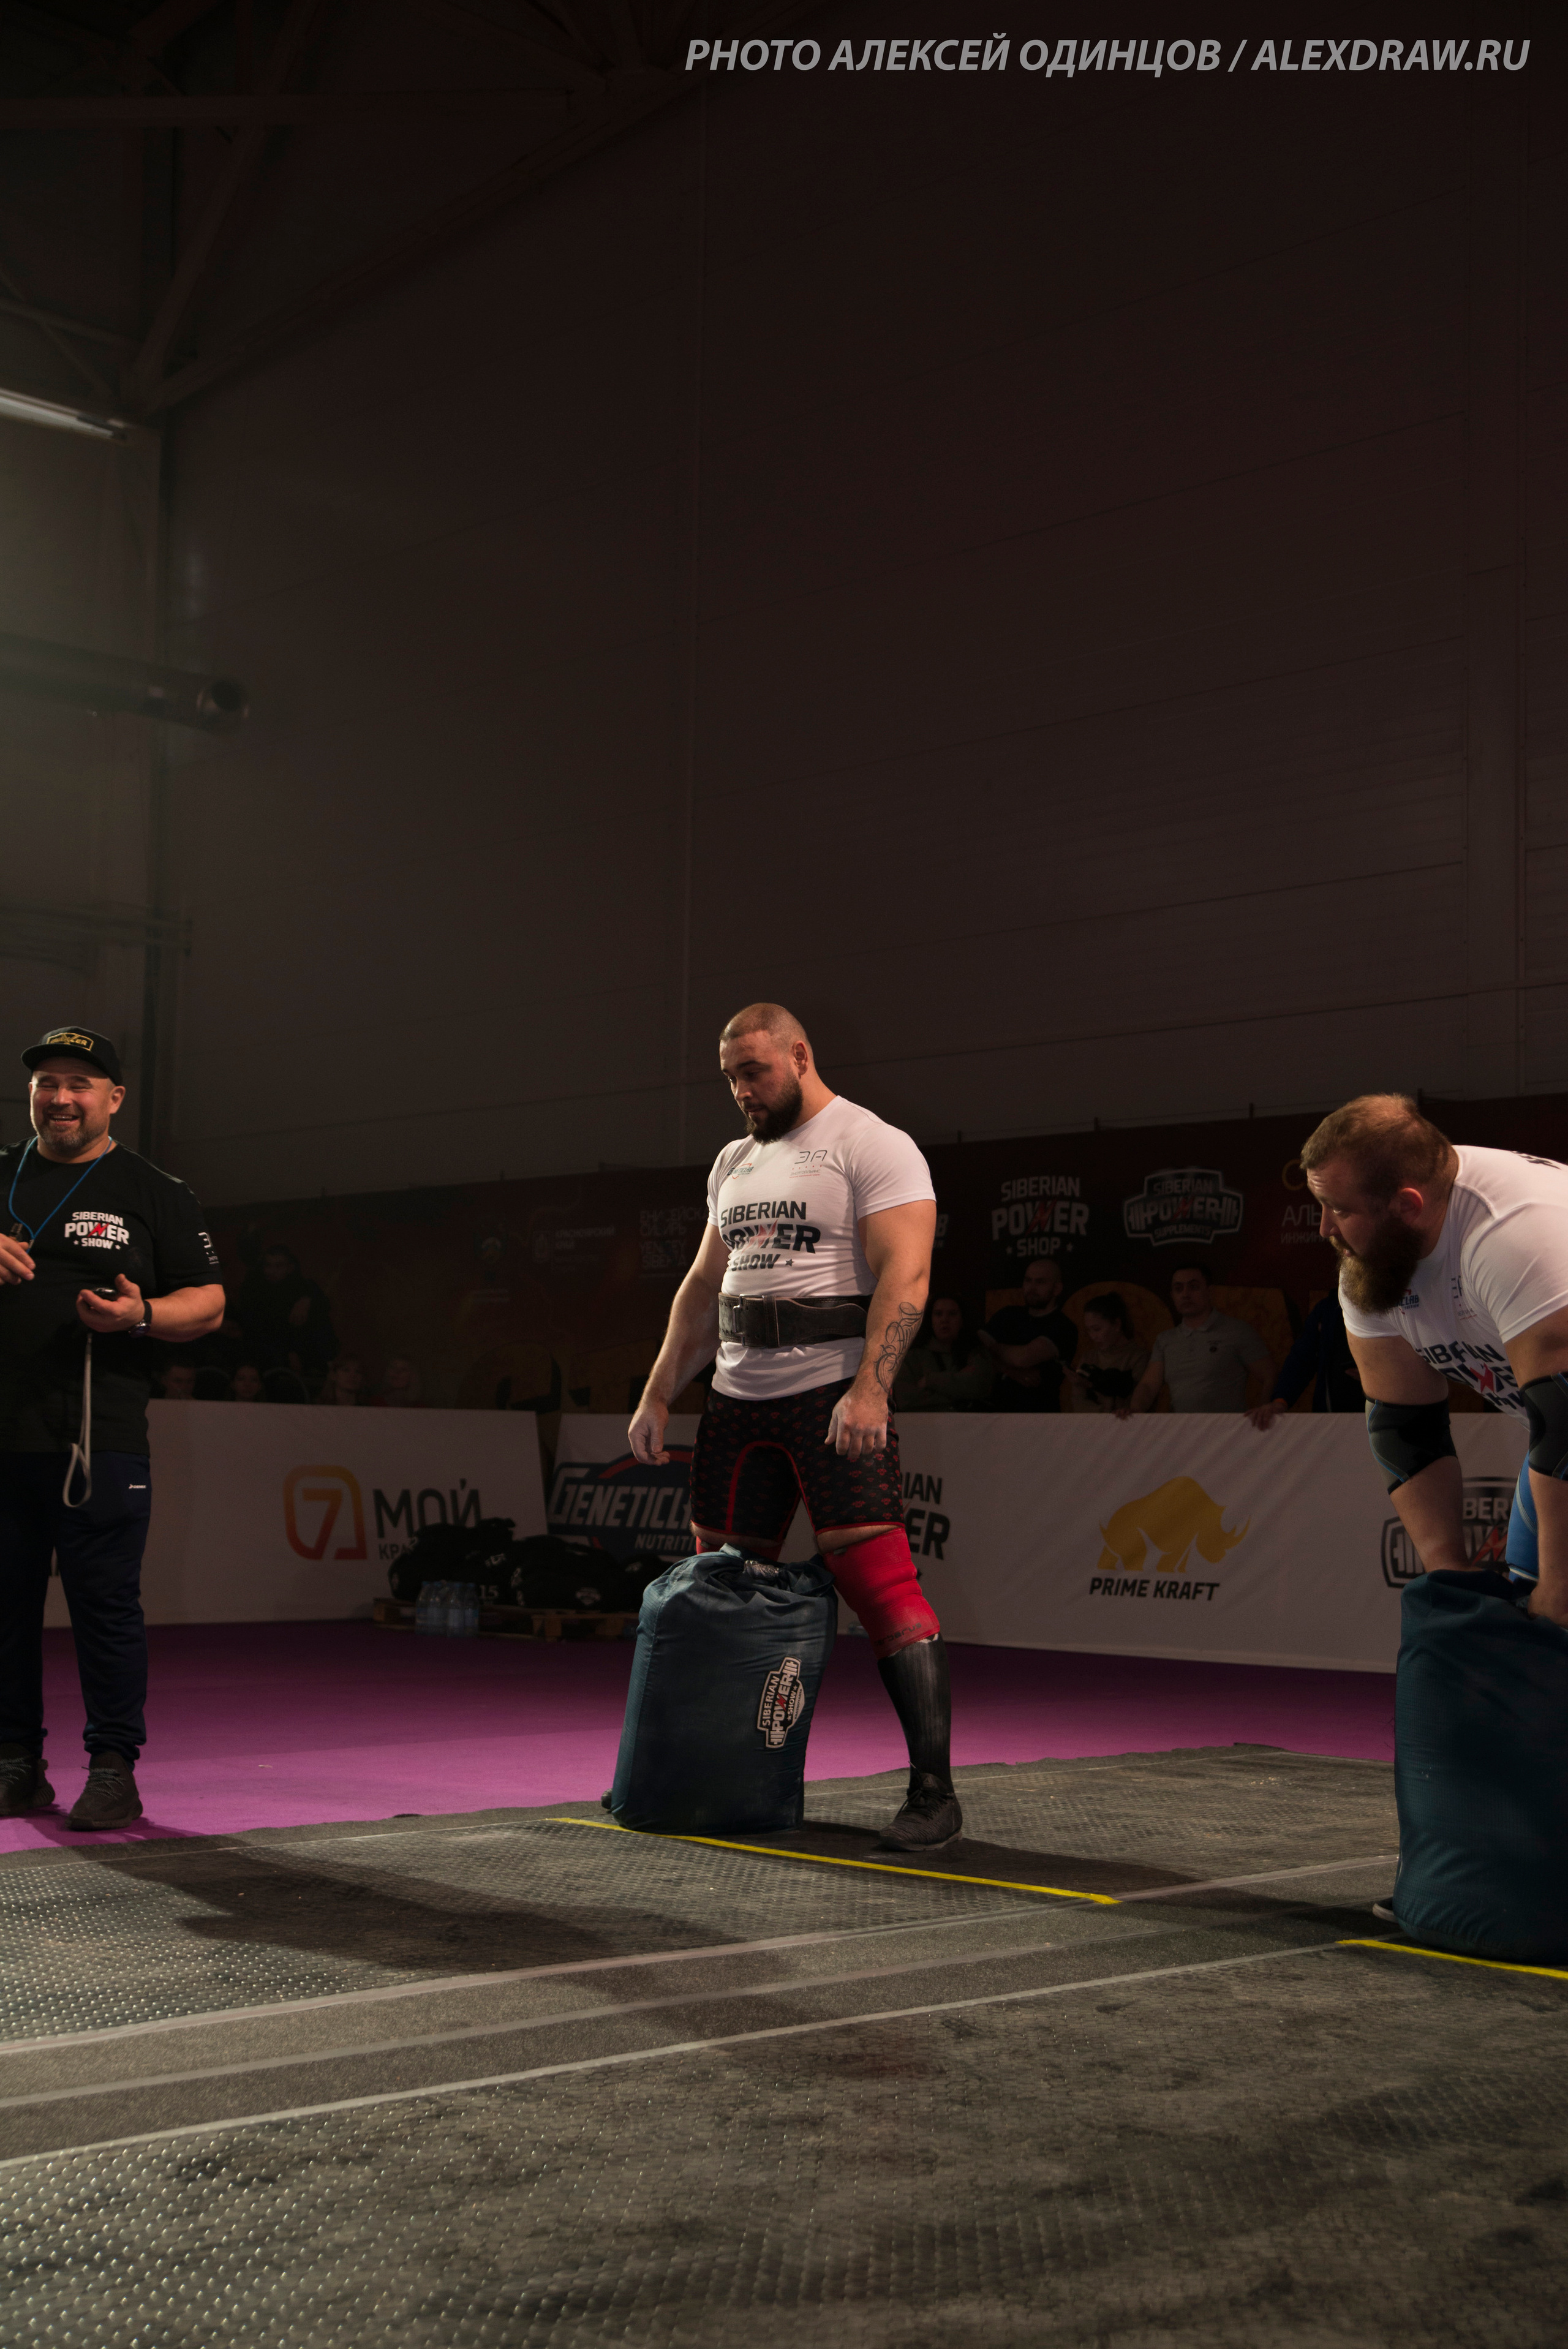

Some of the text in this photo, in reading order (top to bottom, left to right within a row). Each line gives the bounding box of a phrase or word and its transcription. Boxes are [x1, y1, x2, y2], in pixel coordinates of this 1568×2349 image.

[1000, 1175, 1080, 1202] SIBERIAN
[1152, 1177, 1213, 1197] SIBERIAN
[72, 1211, 124, 1227] SIBERIAN
[721, 1201, 806, 1228] SIBERIAN
[991, 1199, 1090, 1241] POWER
[1146, 1195, 1220, 1224] POWER
[1281, 1204, 1322, 1227] АЛЬ
[64, 1221, 130, 1245] POWER
[1153, 1223, 1212, 1239] SUPPLEMENTS
[80, 1237, 115, 1250] SHOW
[1016, 1236, 1061, 1257] SHOP
[731, 1254, 782, 1272] SHOW
[372, 1478, 481, 1539] МОЙ
[548, 1468, 692, 1530] GENETICL
[635, 1533, 696, 1551] NUTRITI
[1089, 1577, 1220, 1601] PRIME KRAFT
[762, 1675, 780, 1727] SIBERIAN
[771, 1673, 794, 1731] POWER
[787, 1691, 797, 1716] SHOW
